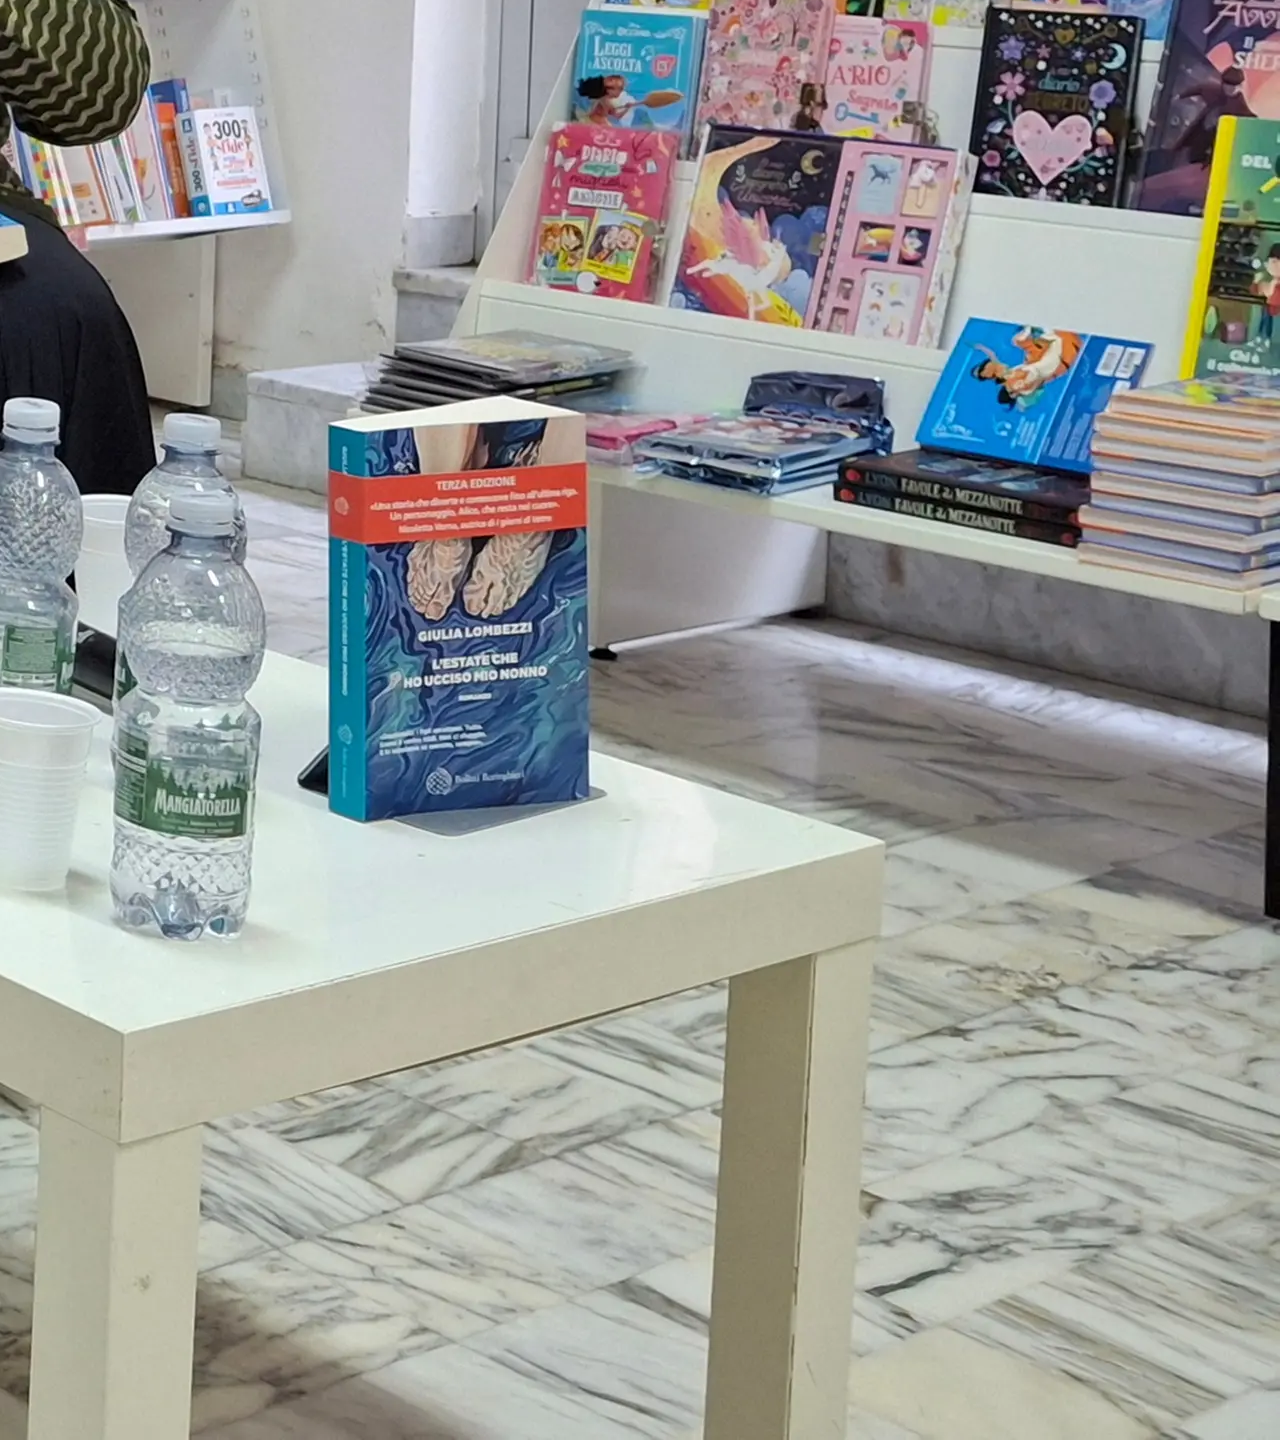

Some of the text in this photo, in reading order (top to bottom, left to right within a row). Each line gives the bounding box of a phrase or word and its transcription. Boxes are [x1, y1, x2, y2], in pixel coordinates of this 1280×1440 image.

[593, 36, 632, 56] LEGGI
[592, 56, 642, 73] ASCOLTA
[212, 120, 241, 139] 300
[1242, 154, 1272, 169] DEL
[436, 476, 516, 491] TERZA EDIZIONE
[901, 476, 941, 500] FAVOLE
[953, 487, 1024, 515] MEZZANOTTE
[894, 496, 1017, 535] FAVOLE MEZZANOTTE
[417, 622, 532, 642] GIULIA LOMBEZZI
[432, 652, 519, 670] L'ESTATE CHE
[403, 666, 548, 689] HO UCCISO MIO NONNO
[154, 788, 240, 816] MANGIATORELLA
